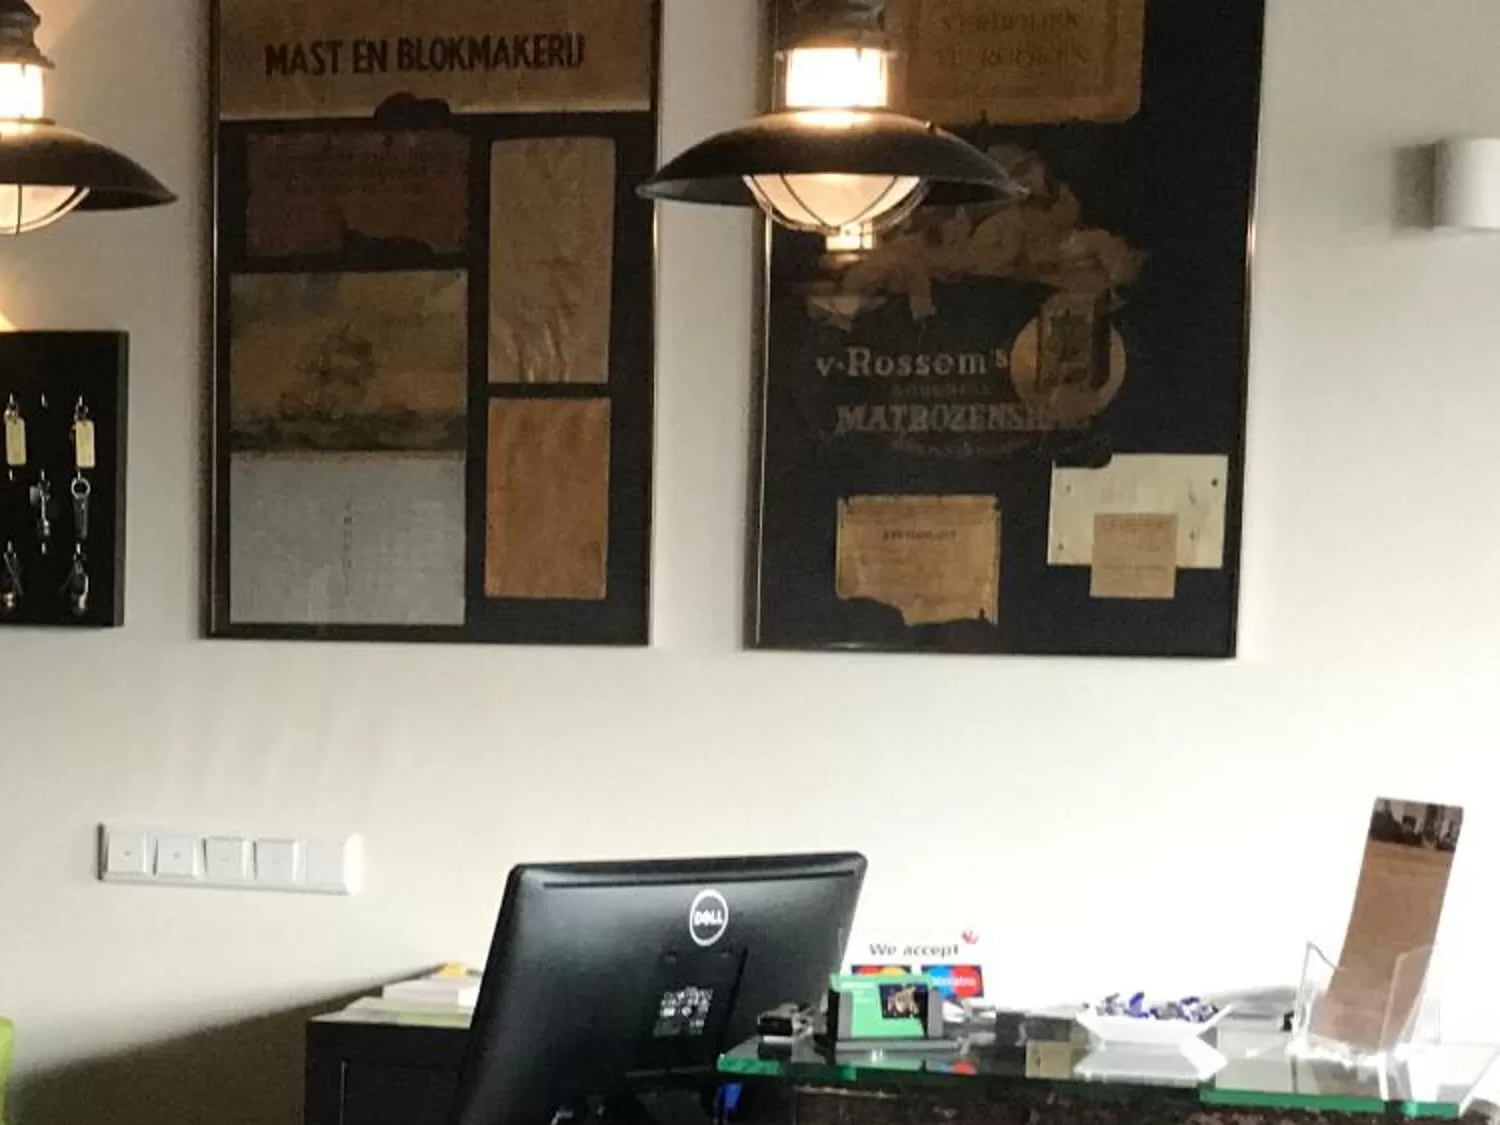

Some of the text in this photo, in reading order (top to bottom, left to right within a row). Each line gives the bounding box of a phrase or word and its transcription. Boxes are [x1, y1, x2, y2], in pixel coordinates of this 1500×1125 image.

[264, 33, 586, 76] MAST EN BLOKMAKERIJ
[693, 909, 723, 926] DELL
[868, 941, 960, 959] We accept
